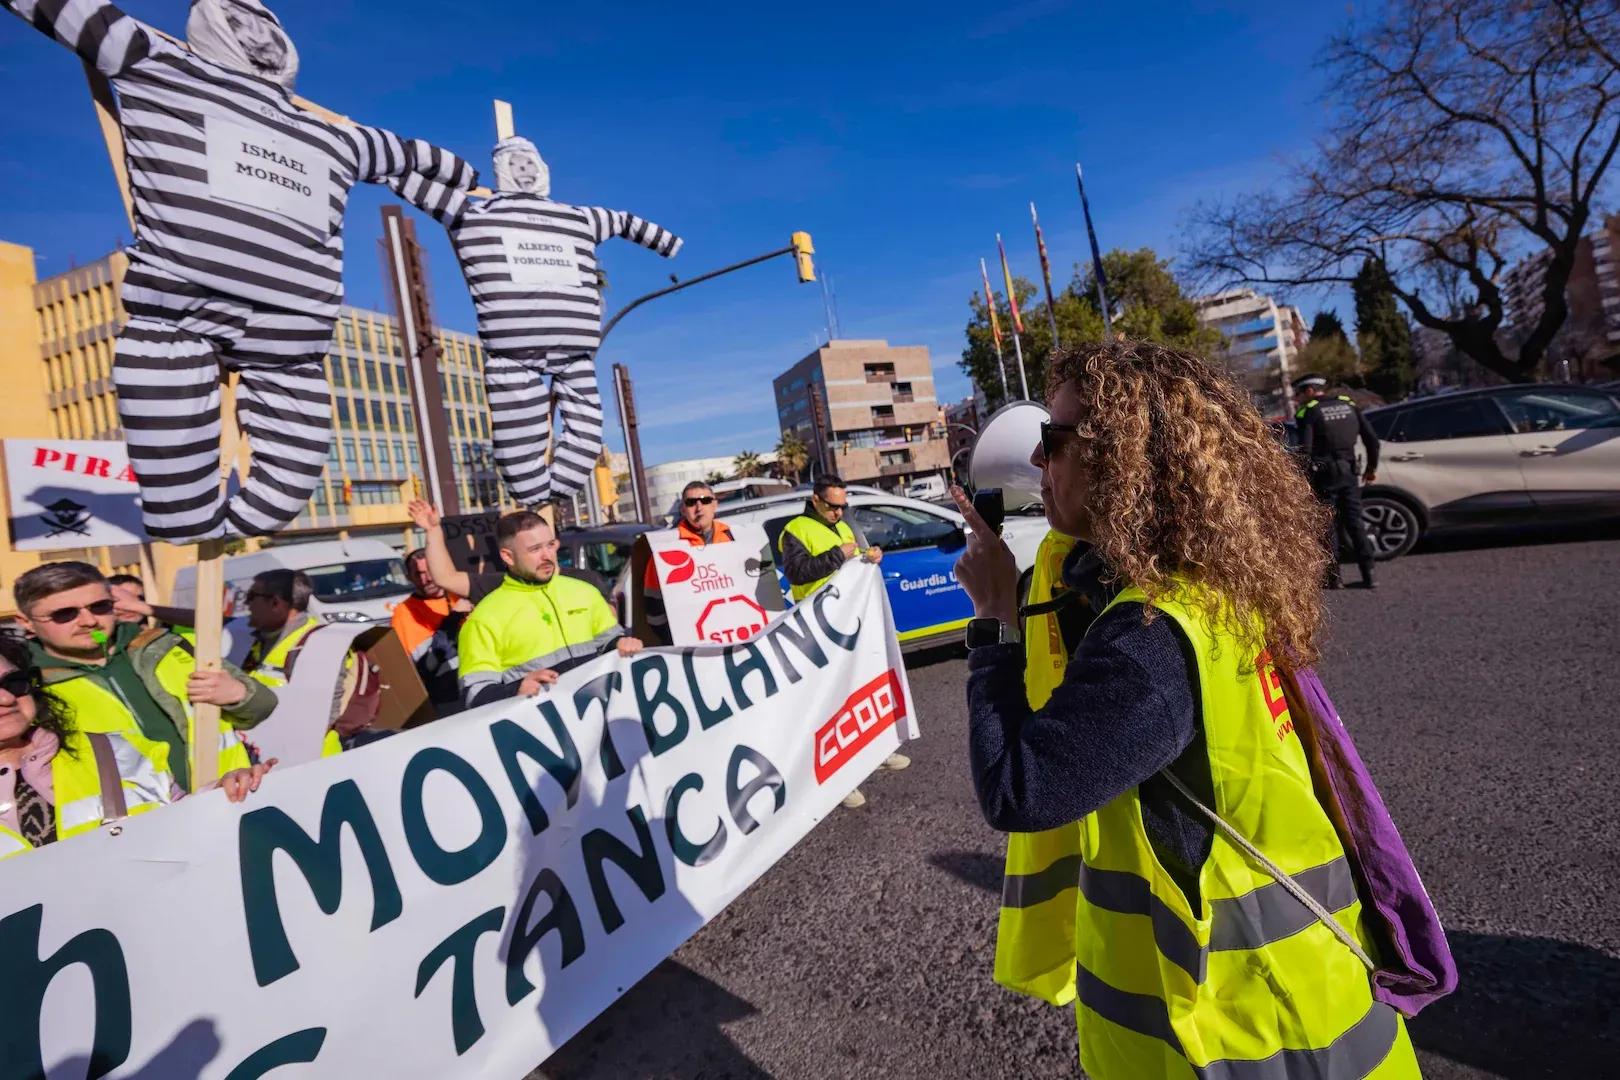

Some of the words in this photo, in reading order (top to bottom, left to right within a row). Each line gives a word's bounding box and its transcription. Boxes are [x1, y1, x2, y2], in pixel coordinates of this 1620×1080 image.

[241, 141, 308, 175] ISMAEL
[235, 161, 312, 197] MORENO
[513, 256, 573, 267] FORCADELL
[517, 242, 564, 253] ALBERTO
[32, 447, 139, 483] PIRA
[691, 574, 735, 594] Smith
[698, 563, 718, 579] DS
[819, 683, 898, 767] CCOO
[239, 584, 861, 988] MONTBLANC
[414, 744, 786, 1056] TANCA
